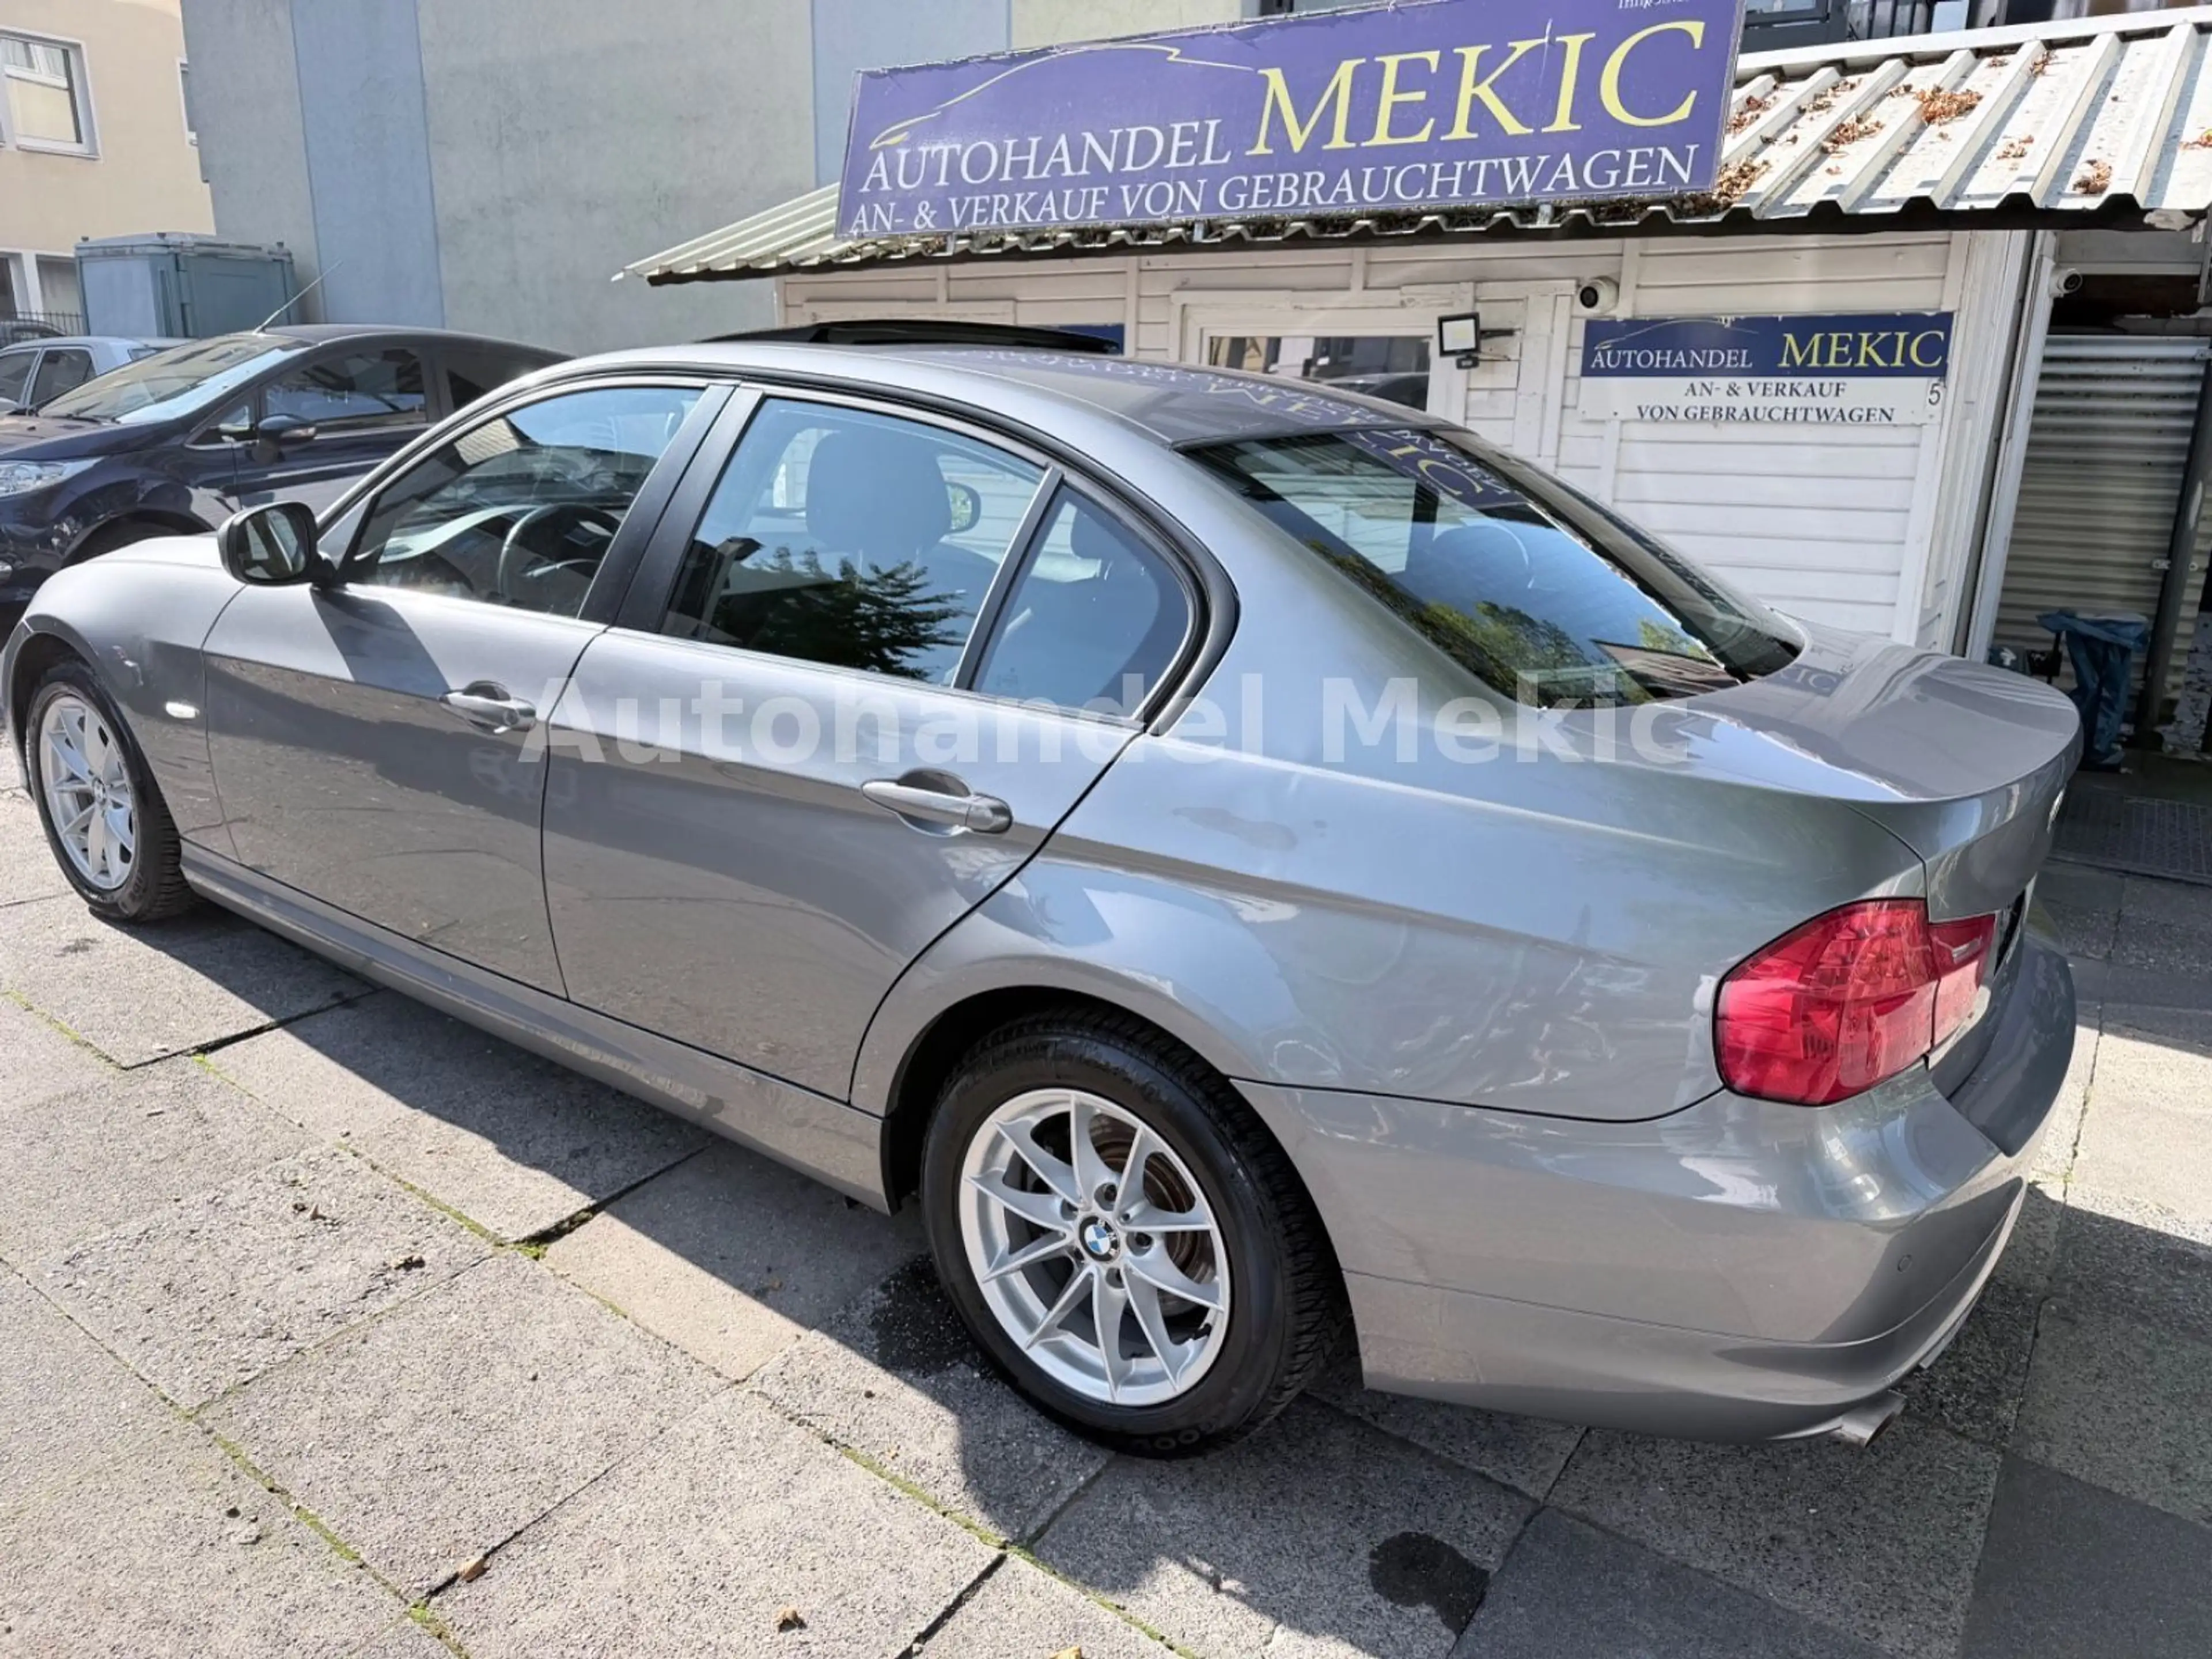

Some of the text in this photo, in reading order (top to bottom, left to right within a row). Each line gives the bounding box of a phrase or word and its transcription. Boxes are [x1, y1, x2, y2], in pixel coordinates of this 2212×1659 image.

[859, 21, 1706, 192] AUTOHANDEL MEKIC
[851, 144, 1699, 233] AN- & VERKAUF VON GEBRAUCHTWAGEN
[1590, 331, 1945, 369] AUTOHANDEL MEKIC
[1684, 382, 1846, 397] AN- & VERKAUF
[1929, 382, 1941, 406] 5
[1637, 405, 1895, 423] VON GEBRAUCHTWAGEN
